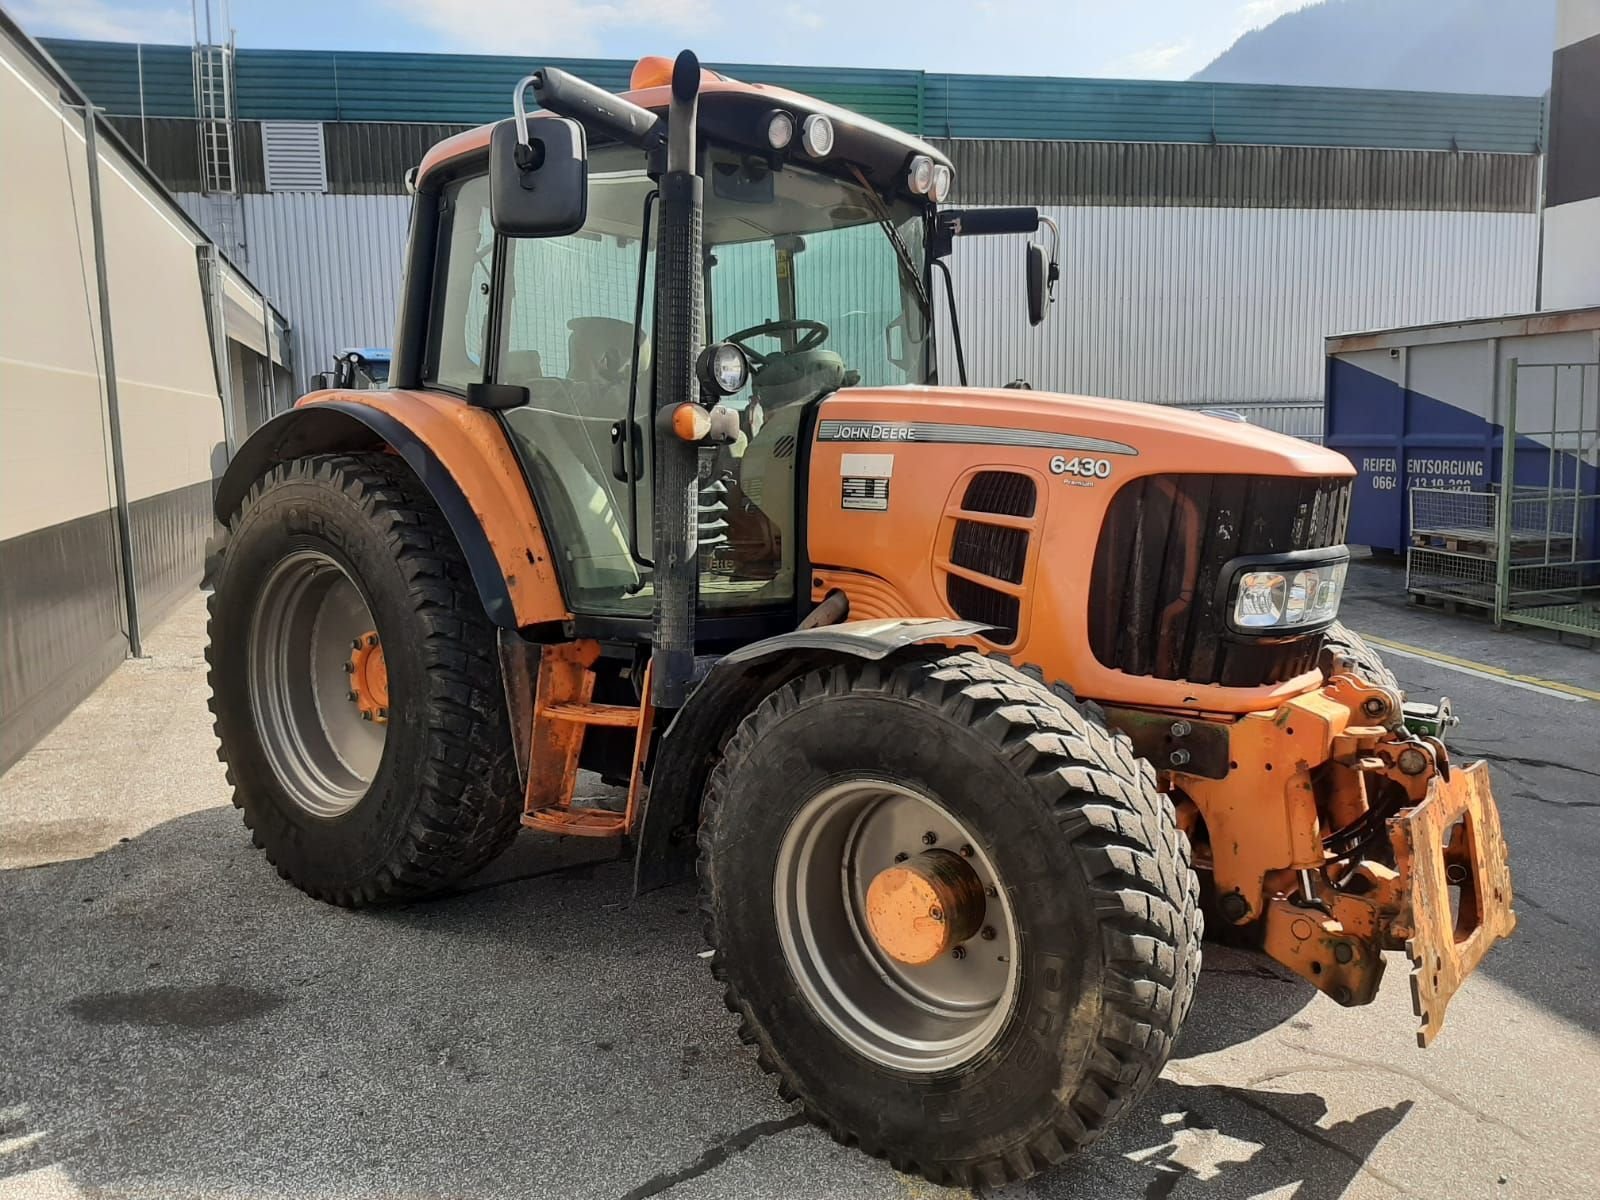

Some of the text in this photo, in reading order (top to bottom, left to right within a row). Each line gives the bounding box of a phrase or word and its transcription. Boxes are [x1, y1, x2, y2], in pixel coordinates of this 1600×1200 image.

[833, 424, 916, 441] JOHN DEERE
[1049, 455, 1111, 478] 6430
[1363, 458, 1483, 475] REIFEN ENTSORGUNG
